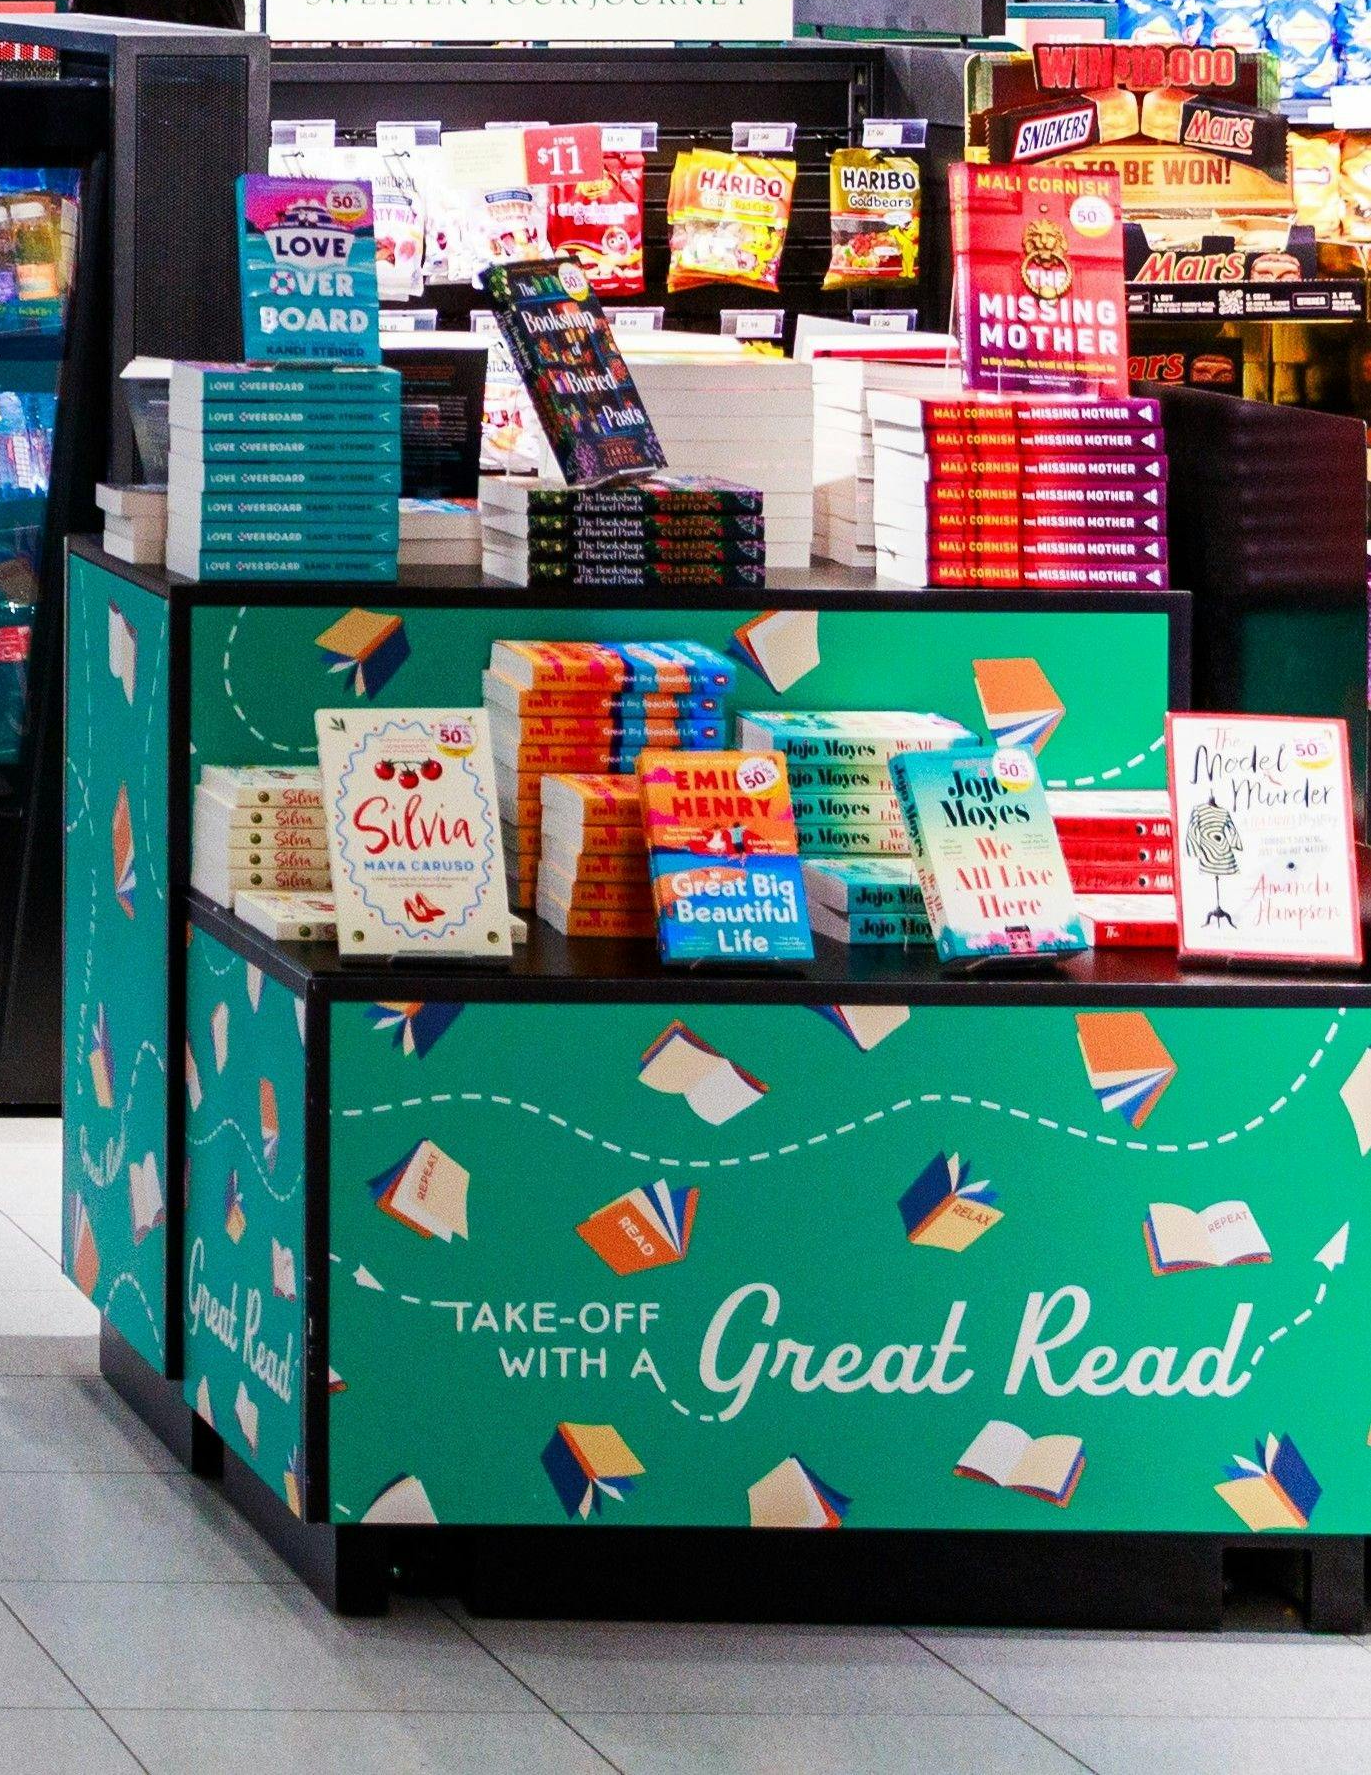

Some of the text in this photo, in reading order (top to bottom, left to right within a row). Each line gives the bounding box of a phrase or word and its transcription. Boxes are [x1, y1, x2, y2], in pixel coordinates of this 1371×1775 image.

[1038, 45, 1236, 89] WIN $10,000
[1018, 113, 1090, 154] SNICKERS
[1184, 109, 1254, 147] Mars
[537, 144, 586, 176] $11
[1124, 159, 1232, 186] BE WON!
[699, 171, 783, 200] HARIBO
[842, 168, 917, 190] HARIBO
[977, 174, 1110, 195] MALI CORNISH
[849, 195, 913, 209] Goldbears
[275, 236, 347, 257] LOVE
[1026, 270, 1068, 289] THE
[1134, 251, 1246, 283] Mars
[516, 281, 537, 298] The
[259, 306, 369, 334] BOARD
[520, 306, 596, 334] Bookshop
[978, 292, 1119, 326] MISSING
[266, 344, 365, 357] KANDI STEINER
[572, 341, 582, 356] of
[979, 322, 1119, 355] MOTHER
[210, 381, 304, 392] LOVE OVERBOARD
[564, 367, 618, 395] Buried
[209, 412, 304, 422] LOVE OVERBOARD
[601, 405, 645, 429] Pasts
[934, 408, 1129, 420] MALI CORNISH MISSING MOTHER
[240, 442, 305, 452] OVERBOARD
[936, 435, 1132, 446] MALI CORNISH MISSING MOTHER
[577, 493, 642, 503] The Bookshop
[585, 503, 644, 512] Buried Pasts
[585, 528, 644, 538] Buried Pasts
[596, 517, 642, 528] Bookshop
[823, 740, 876, 760] Moyes
[896, 740, 932, 751] We All
[1209, 727, 1242, 750] The
[1189, 744, 1290, 785] Model
[817, 768, 870, 789] Moyes
[947, 770, 1009, 804] Jojo
[672, 796, 772, 819] HENRY
[1231, 778, 1336, 813] Murder
[275, 810, 313, 827] Silvia
[352, 794, 477, 855] Silvia
[939, 799, 1031, 831] Moyes
[274, 829, 312, 847] Silvia
[974, 836, 1013, 861] We
[363, 860, 475, 872] MAYA CARUSO
[955, 864, 1054, 891] All Live
[752, 874, 795, 903] Big
[855, 886, 893, 906] Jojo
[1244, 873, 1333, 901] Amanda
[676, 896, 799, 924] Beautiful
[977, 894, 1042, 919] Here
[1255, 898, 1341, 931] Hampson
[859, 916, 896, 938] Jojo
[717, 929, 770, 953] Life
[416, 1151, 439, 1202] REPEAT
[952, 1202, 997, 1227] RELAX
[1207, 1211, 1249, 1234] REPEAT
[617, 1216, 656, 1258] READ
[187, 1237, 292, 1405] Great Read
[438, 1301, 660, 1334] TAKE-OFF
[698, 1282, 1253, 1422] Great Read
[498, 1347, 667, 1393] WITH A
